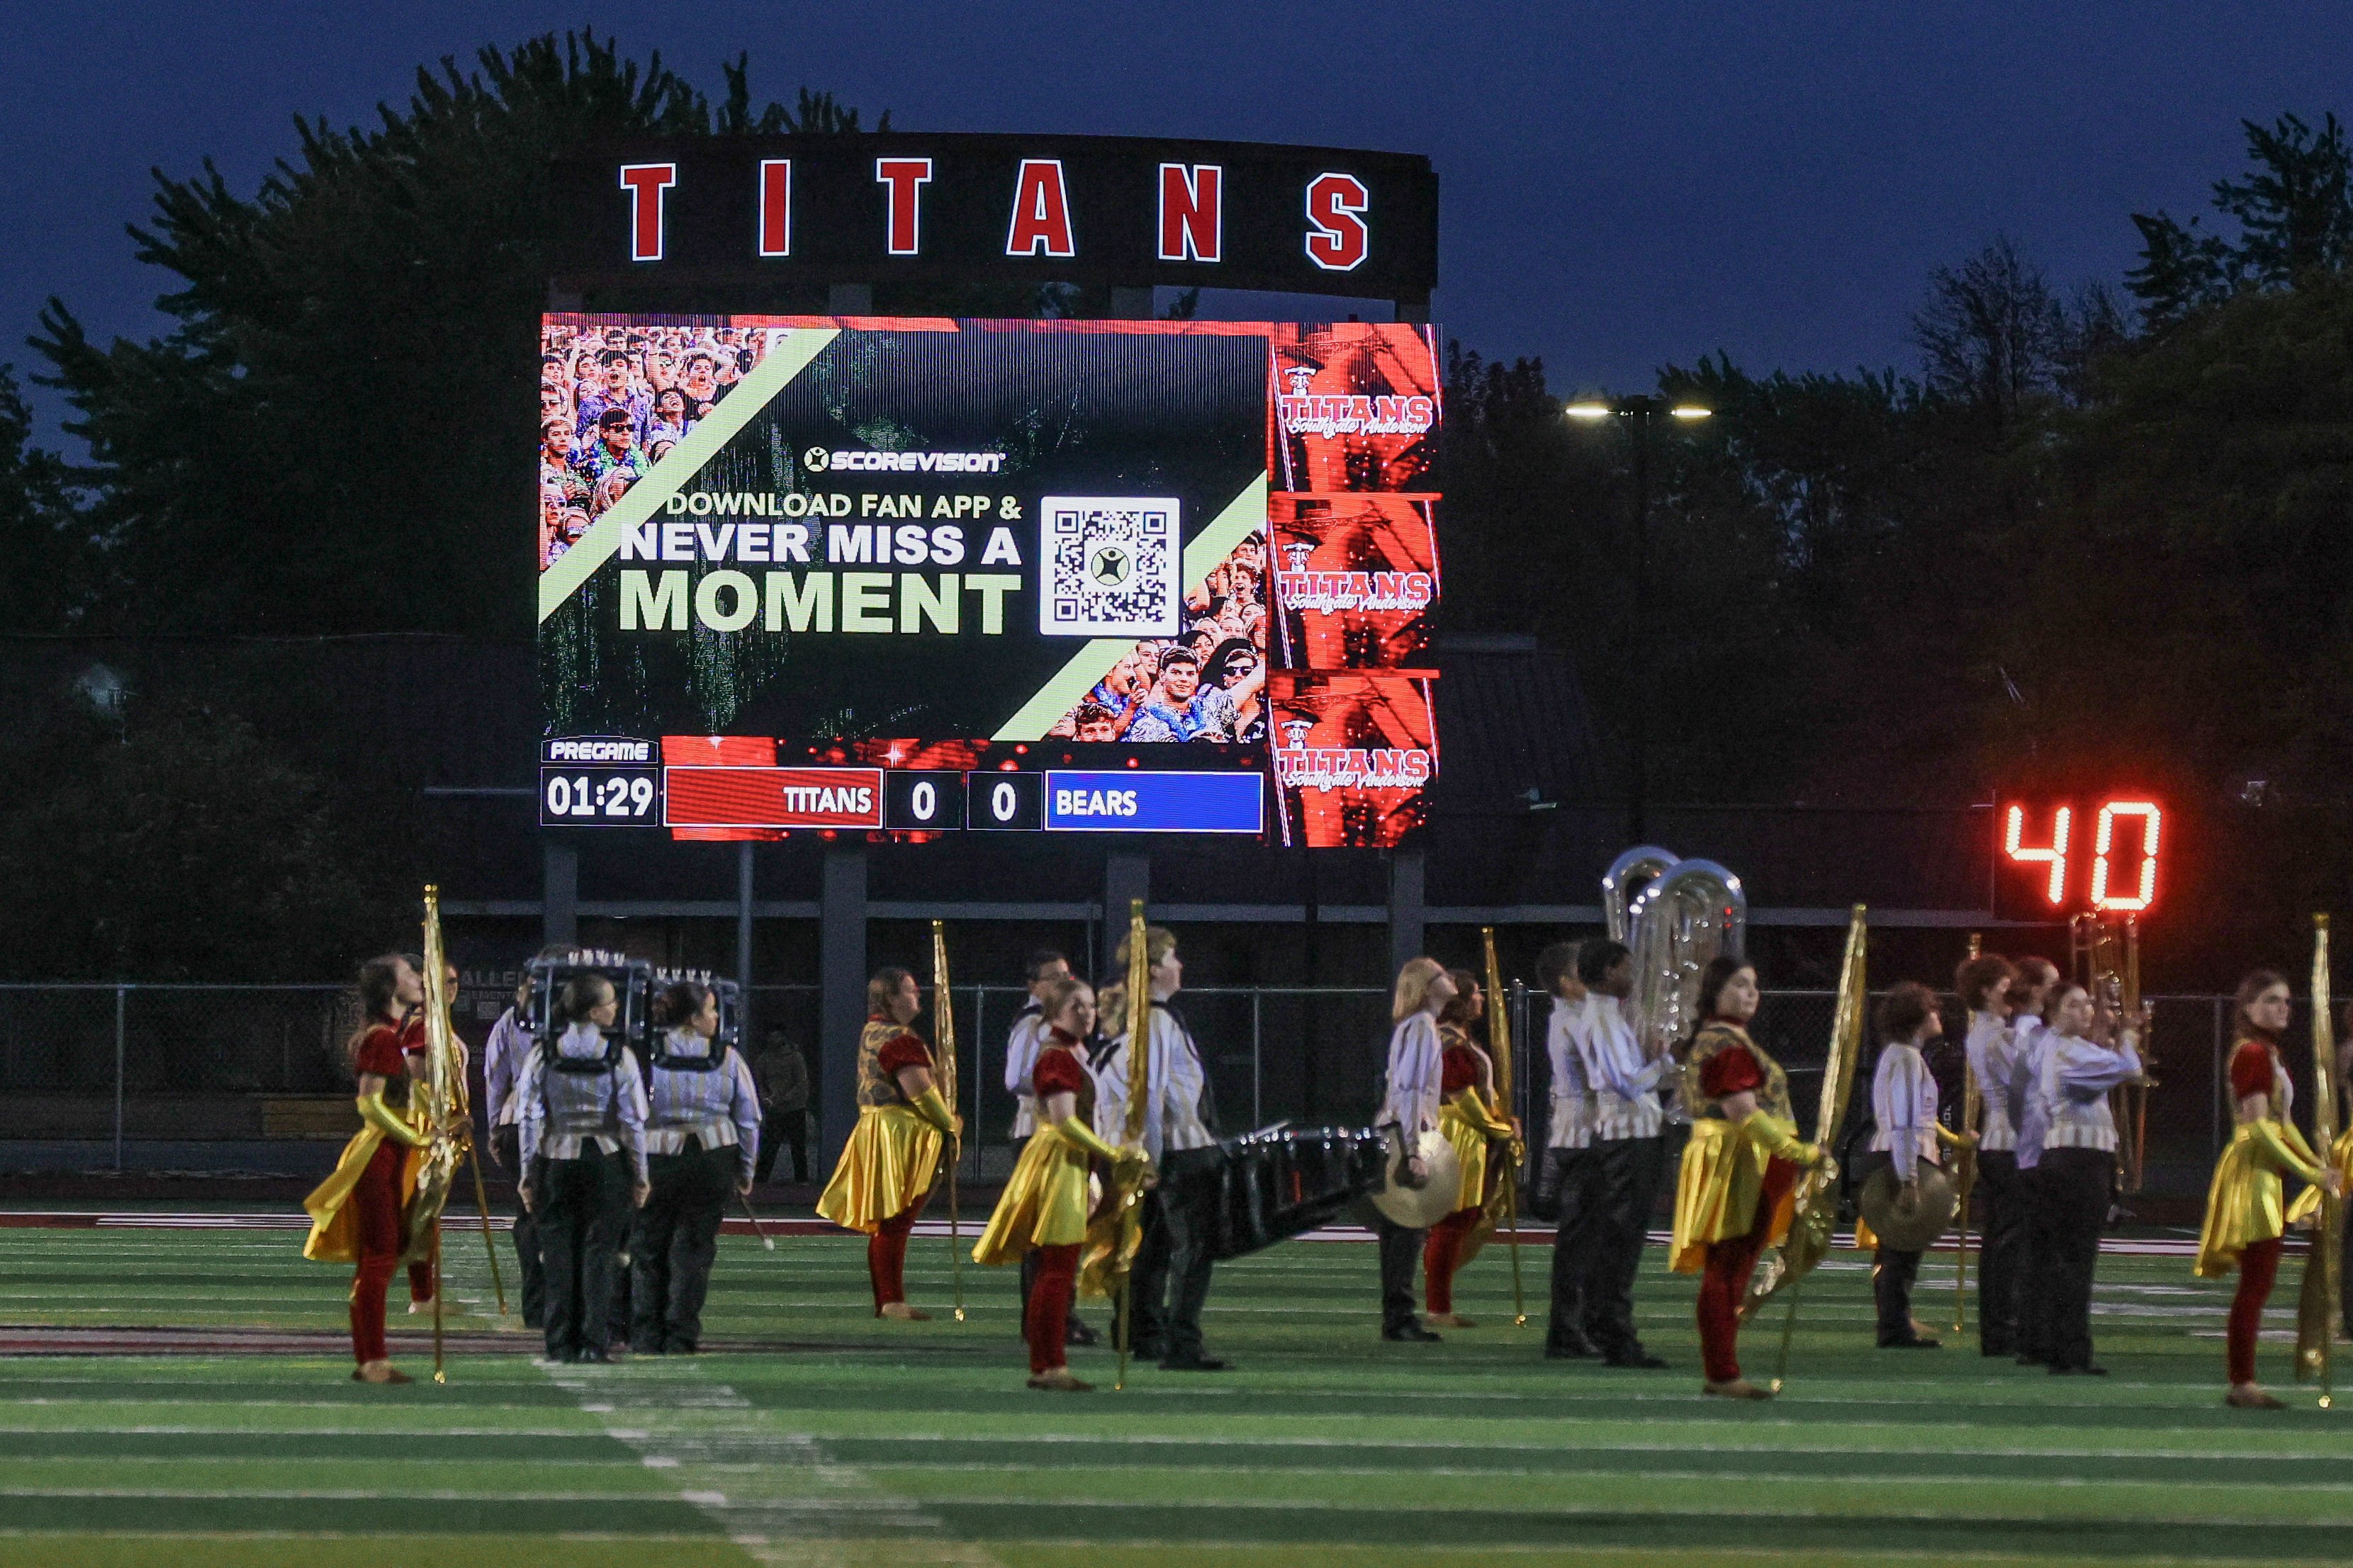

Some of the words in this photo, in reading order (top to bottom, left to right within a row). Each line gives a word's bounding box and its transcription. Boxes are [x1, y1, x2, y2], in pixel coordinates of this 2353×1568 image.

[620, 158, 1368, 271] TITANS
[1281, 394, 1433, 428] TITANS
[1288, 417, 1357, 439] Southgate
[1361, 414, 1427, 435] Anderson
[667, 492, 851, 517] DOWNLOAD
[862, 494, 921, 518] FAN
[931, 495, 991, 519] APP
[999, 496, 1022, 519] &
[620, 522, 811, 562] NEVER
[829, 524, 965, 565] MISS
[981, 526, 1021, 565] A
[619, 570, 1021, 634] MOMENT
[1279, 571, 1431, 604] TITANS
[1287, 594, 1355, 615] Southgate
[1359, 591, 1425, 612] Anderson
[551, 742, 648, 760] PREGAME
[1277, 748, 1429, 782] TITANS
[548, 777, 653, 816] 01:29
[1286, 771, 1354, 792] Southgate
[1358, 769, 1424, 789] Anderson
[783, 786, 872, 813] TITANS
[912, 782, 936, 820] 0
[992, 782, 1016, 820] 0
[1057, 790, 1138, 816] BEARS
[2005, 802, 2161, 910] 40
